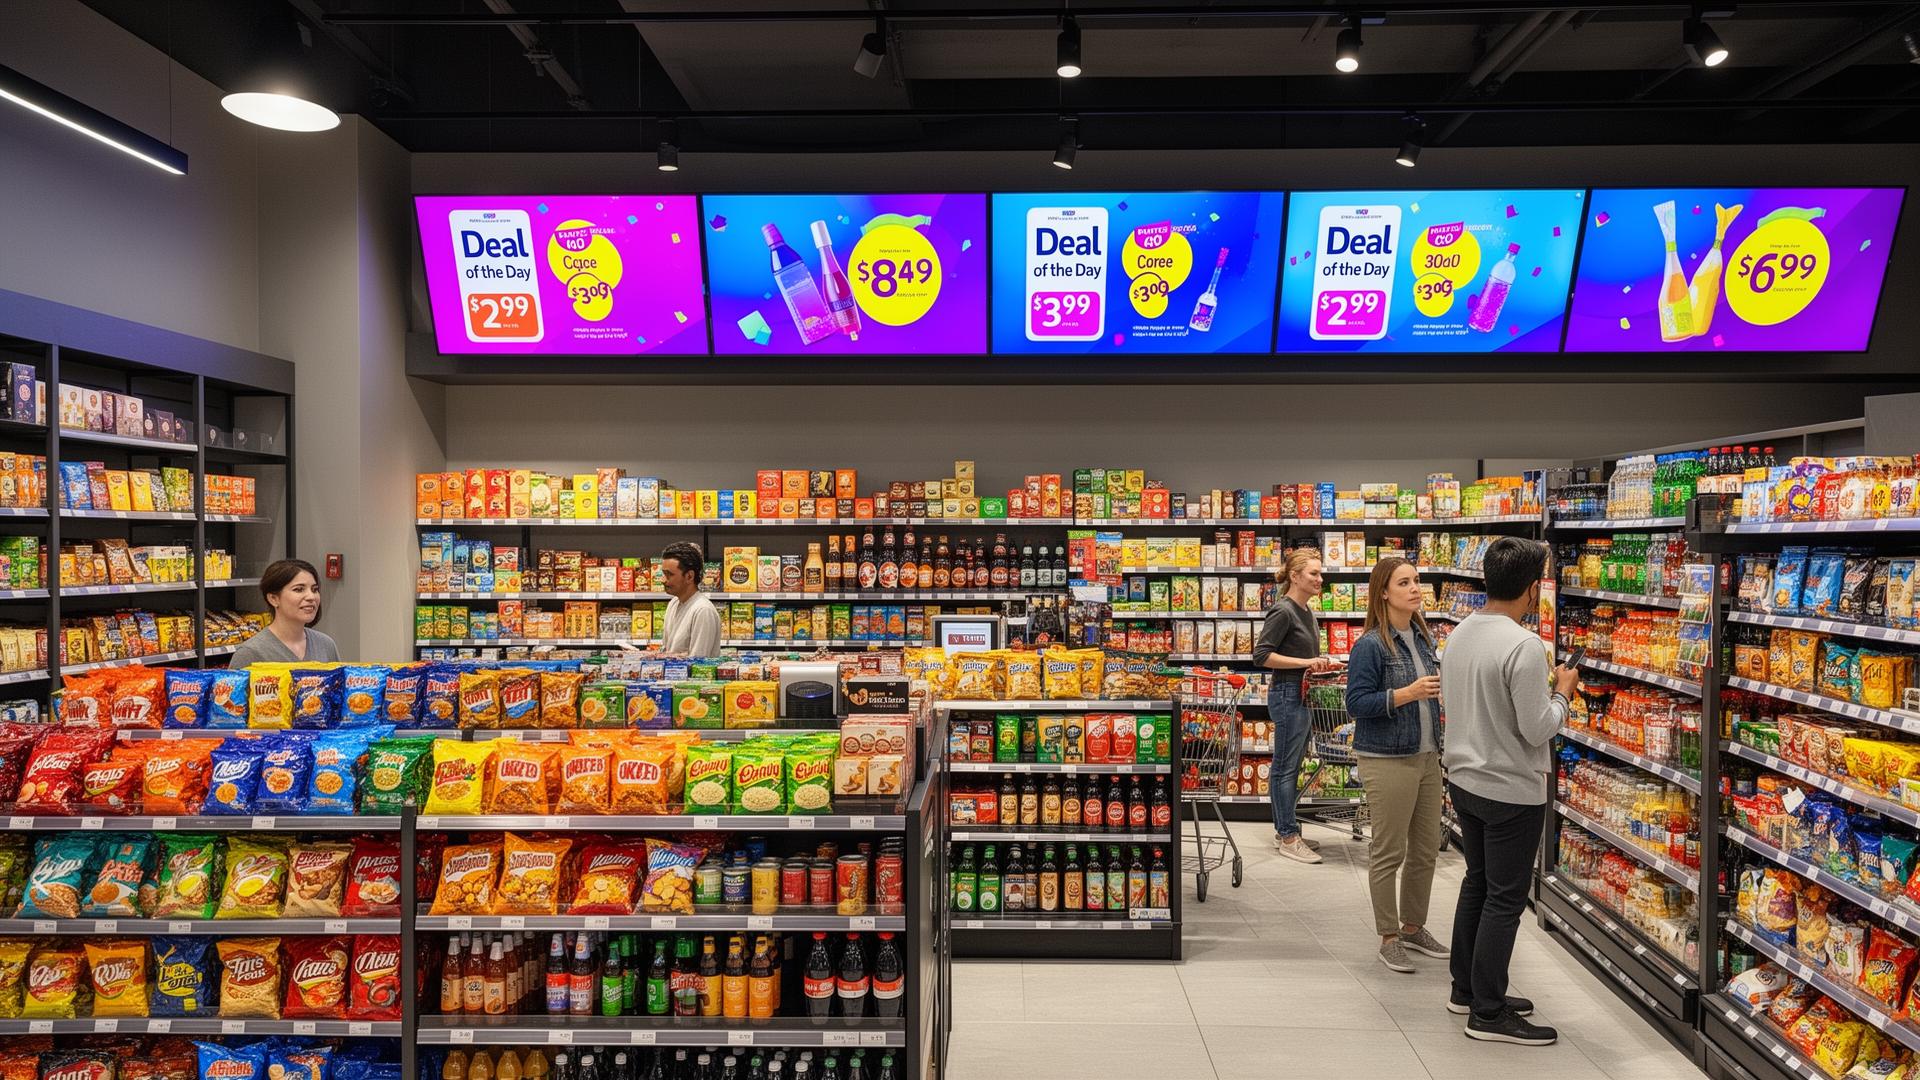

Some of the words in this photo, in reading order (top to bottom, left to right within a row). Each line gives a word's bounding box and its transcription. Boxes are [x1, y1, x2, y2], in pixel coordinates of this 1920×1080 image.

[460, 228, 529, 258] Deal
[1035, 226, 1102, 256] Deal
[1326, 225, 1393, 255] Deal
[465, 265, 480, 279] of
[481, 264, 503, 279] the
[506, 265, 531, 281] Day
[857, 258, 933, 298] $849
[1033, 263, 1048, 277] of
[1050, 262, 1073, 277] the
[1075, 264, 1102, 279] Day
[1322, 262, 1338, 276] of
[1339, 262, 1362, 276] the
[1363, 263, 1390, 278] Day
[1737, 253, 1817, 294] $699
[470, 296, 529, 329] $299
[1033, 294, 1091, 327] $399
[1320, 292, 1379, 326] $299
